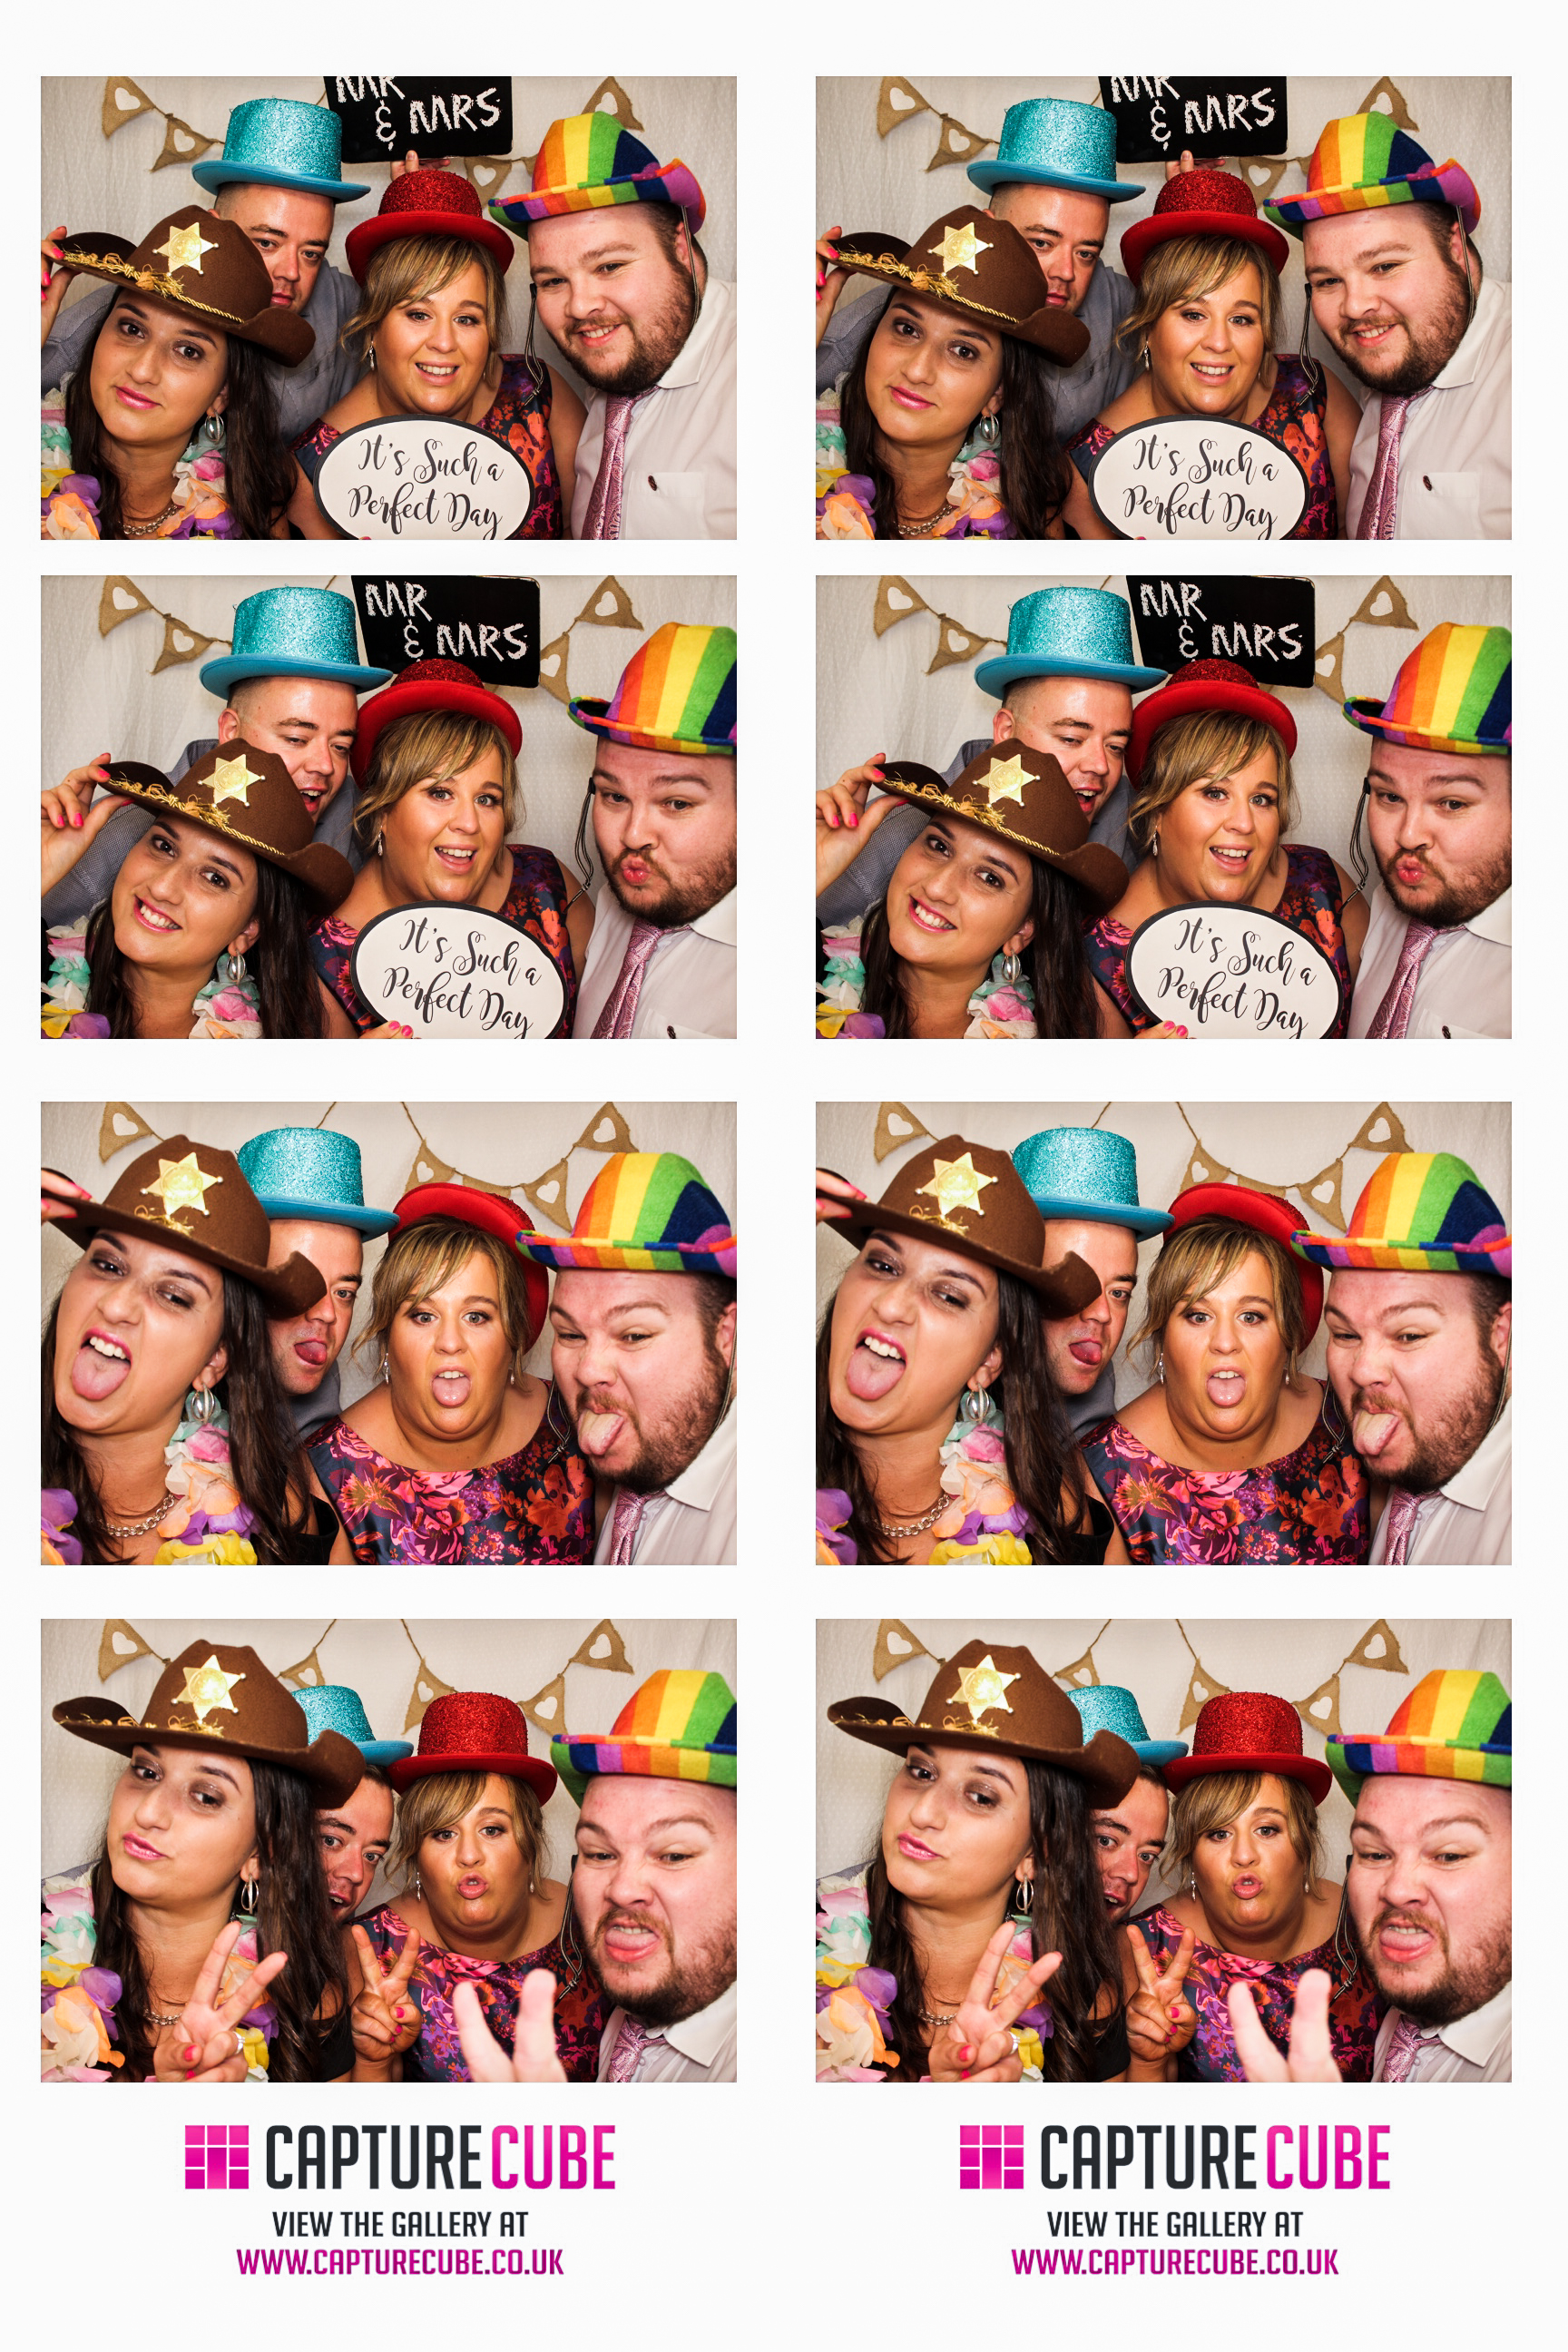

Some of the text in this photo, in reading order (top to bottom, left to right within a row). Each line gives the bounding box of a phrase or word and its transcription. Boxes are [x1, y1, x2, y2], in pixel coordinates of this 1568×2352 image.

[375, 87, 502, 151] & MRS
[1150, 87, 1277, 151] & MRS
[358, 434, 505, 485] It's Such a
[1132, 434, 1279, 485] It's Such a
[348, 482, 504, 540] Perfect Day
[1122, 482, 1279, 540] Perfect Day
[365, 580, 433, 622] MR
[1140, 580, 1208, 622] MR
[403, 618, 529, 662] & MRS
[1178, 618, 1304, 662] & MRS
[399, 916, 543, 986] It's Such a
[1174, 916, 1318, 986] It's Such a
[382, 965, 534, 1039] Perfect Day
[1157, 965, 1308, 1039] Perfect Day
